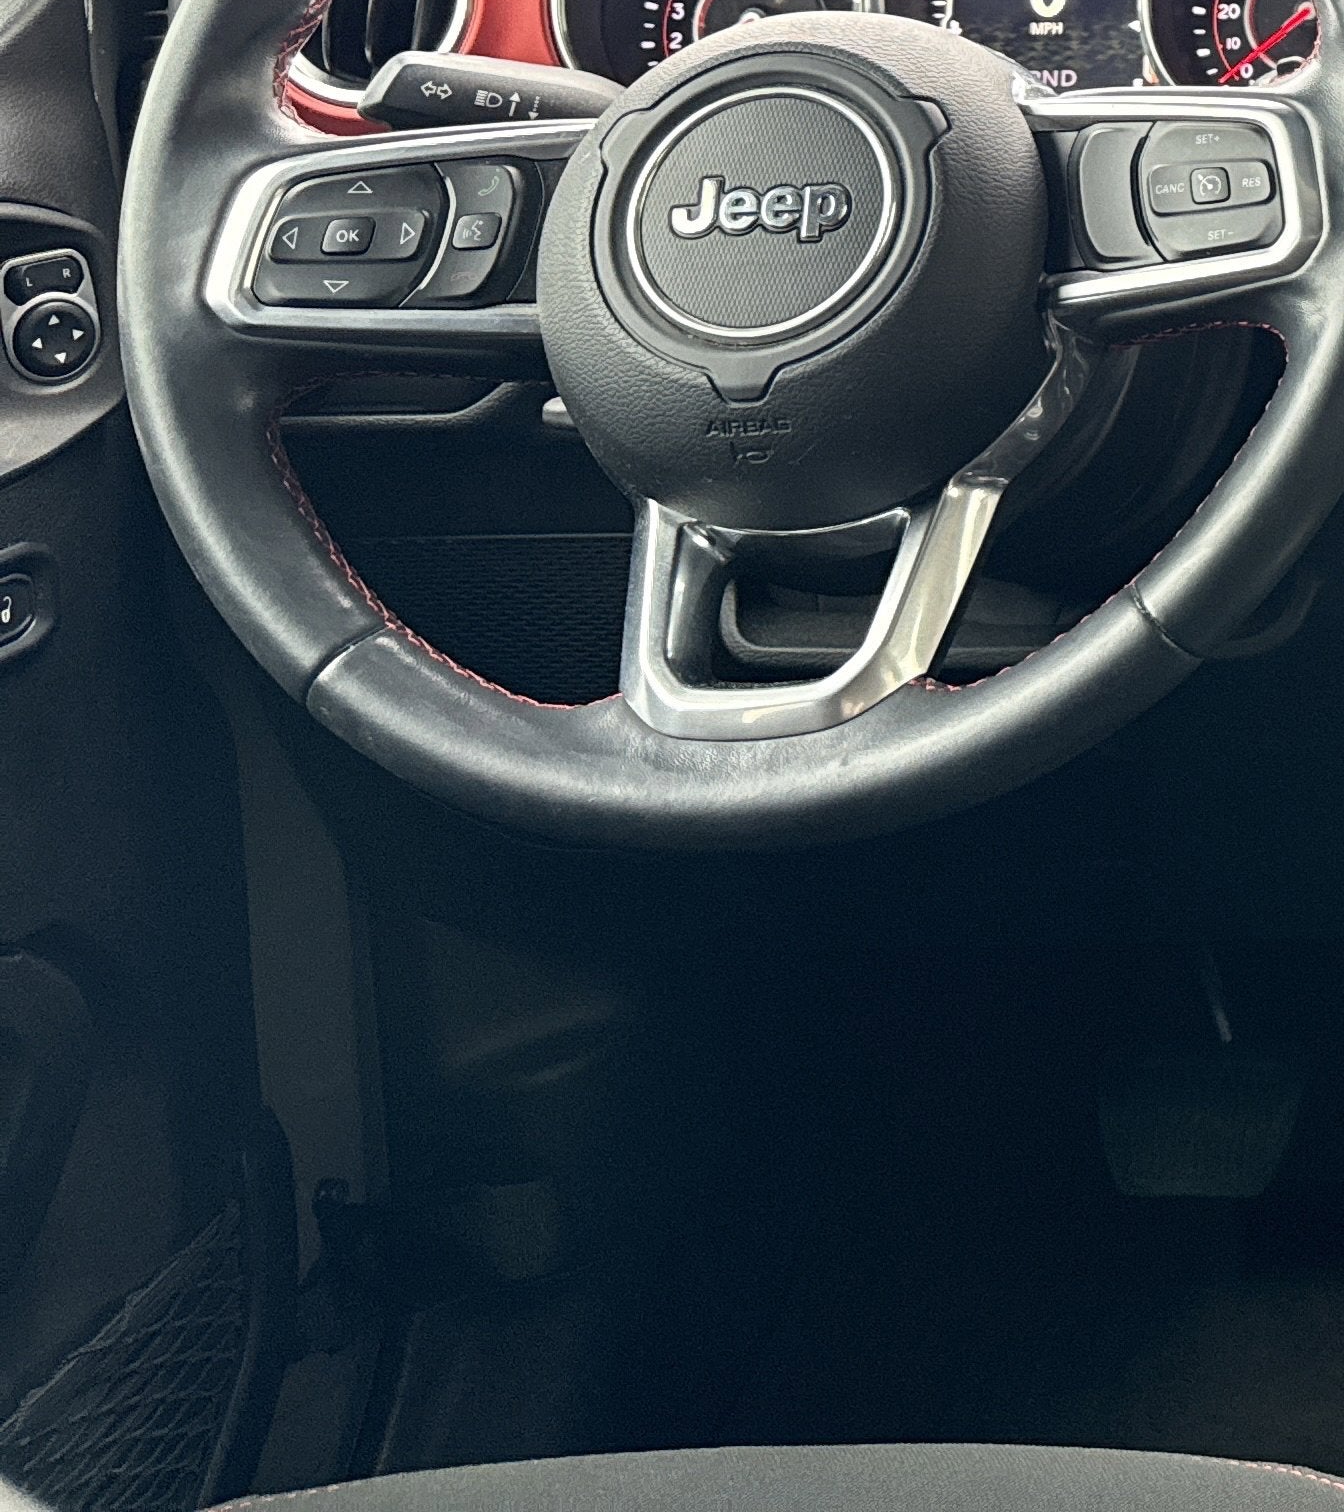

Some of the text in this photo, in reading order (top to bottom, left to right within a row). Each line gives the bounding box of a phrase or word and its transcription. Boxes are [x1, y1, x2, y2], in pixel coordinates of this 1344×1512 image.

[671, 2, 685, 20] 3
[1217, 3, 1241, 19] 20
[1029, 21, 1064, 35] MPH
[669, 31, 683, 50] 2
[1225, 37, 1242, 50] 10
[1240, 63, 1253, 78] 0
[1155, 182, 1186, 195] CANC
[1241, 176, 1261, 188] RES
[669, 175, 853, 243] Jeep
[336, 228, 361, 243] OK
[62, 268, 72, 278] R
[26, 277, 33, 287] L
[705, 420, 792, 438] AIRBAG
